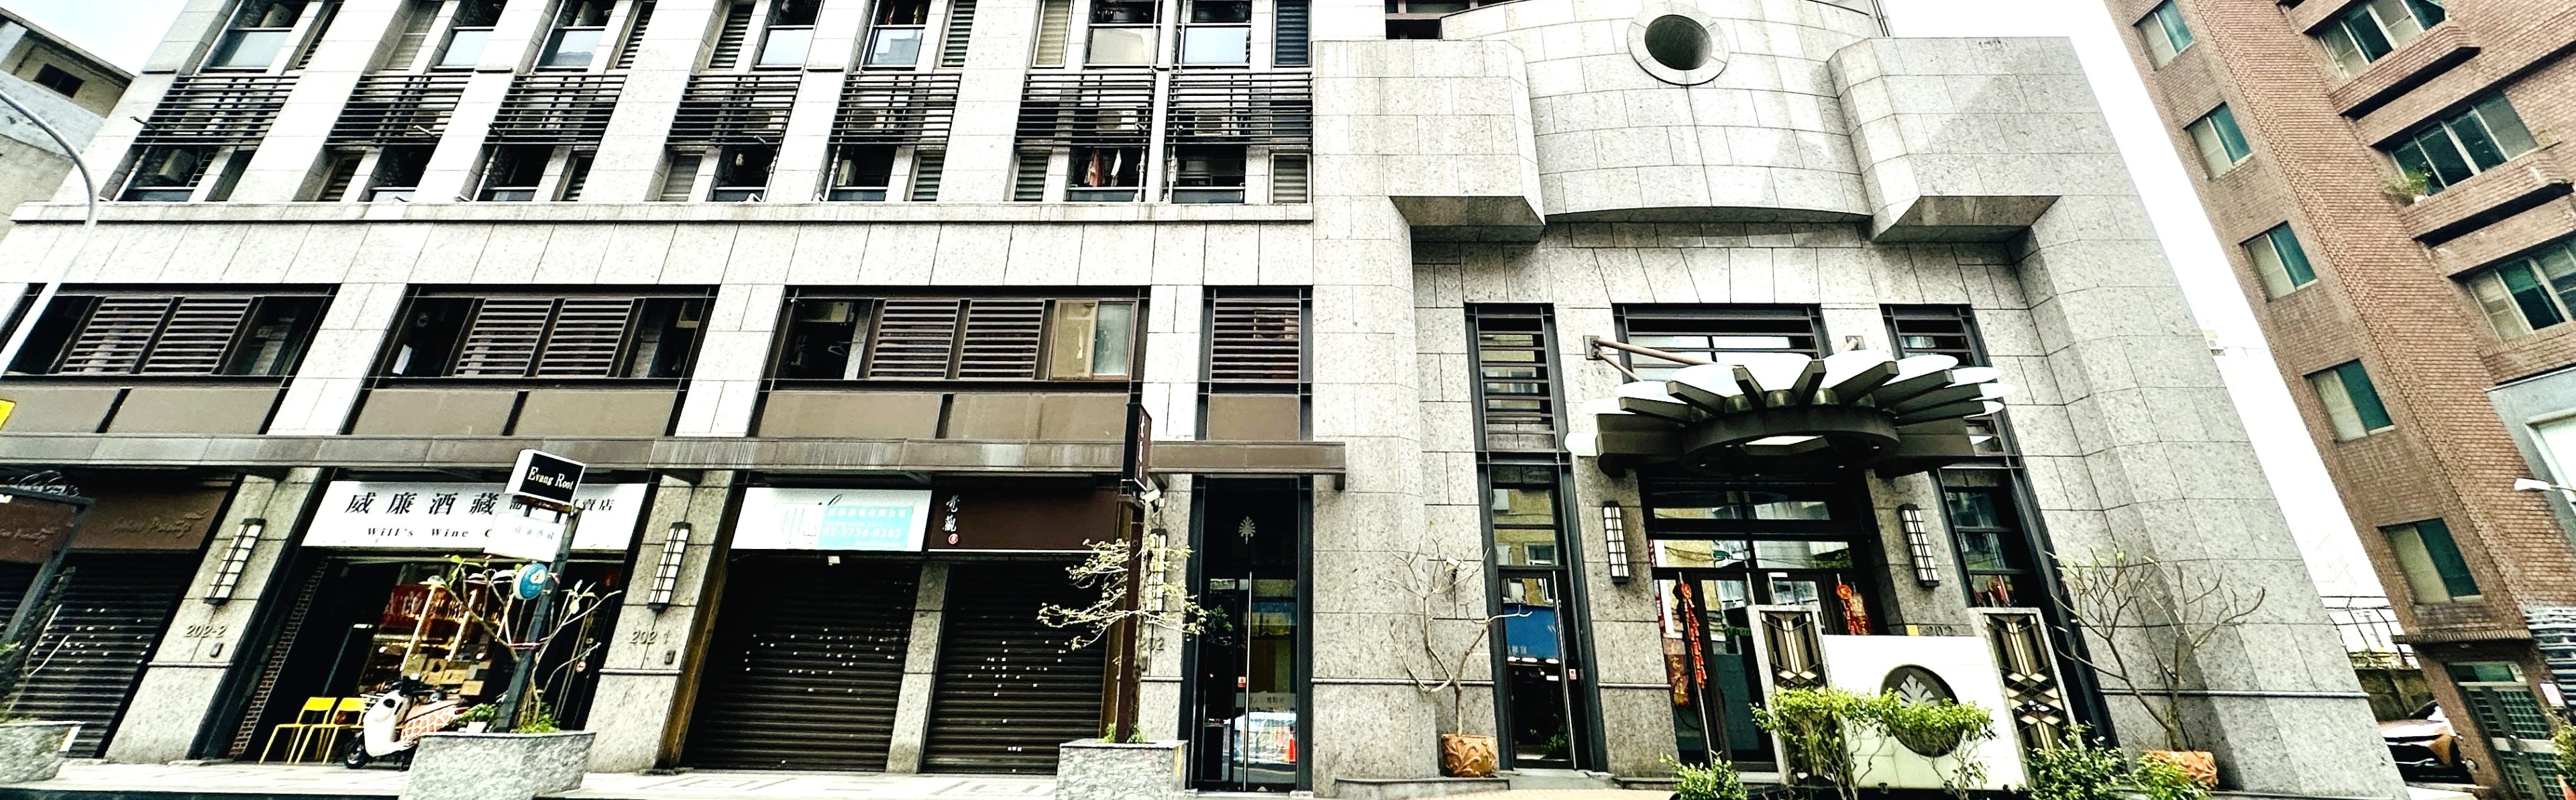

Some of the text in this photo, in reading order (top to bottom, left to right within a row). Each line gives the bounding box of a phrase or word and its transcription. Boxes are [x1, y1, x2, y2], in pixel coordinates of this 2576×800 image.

[528, 466, 574, 490] Evang Root
[344, 492, 499, 515] 威廉酒藏
[368, 528, 469, 538] Will's Wine
[183, 625, 228, 638] 202-2
